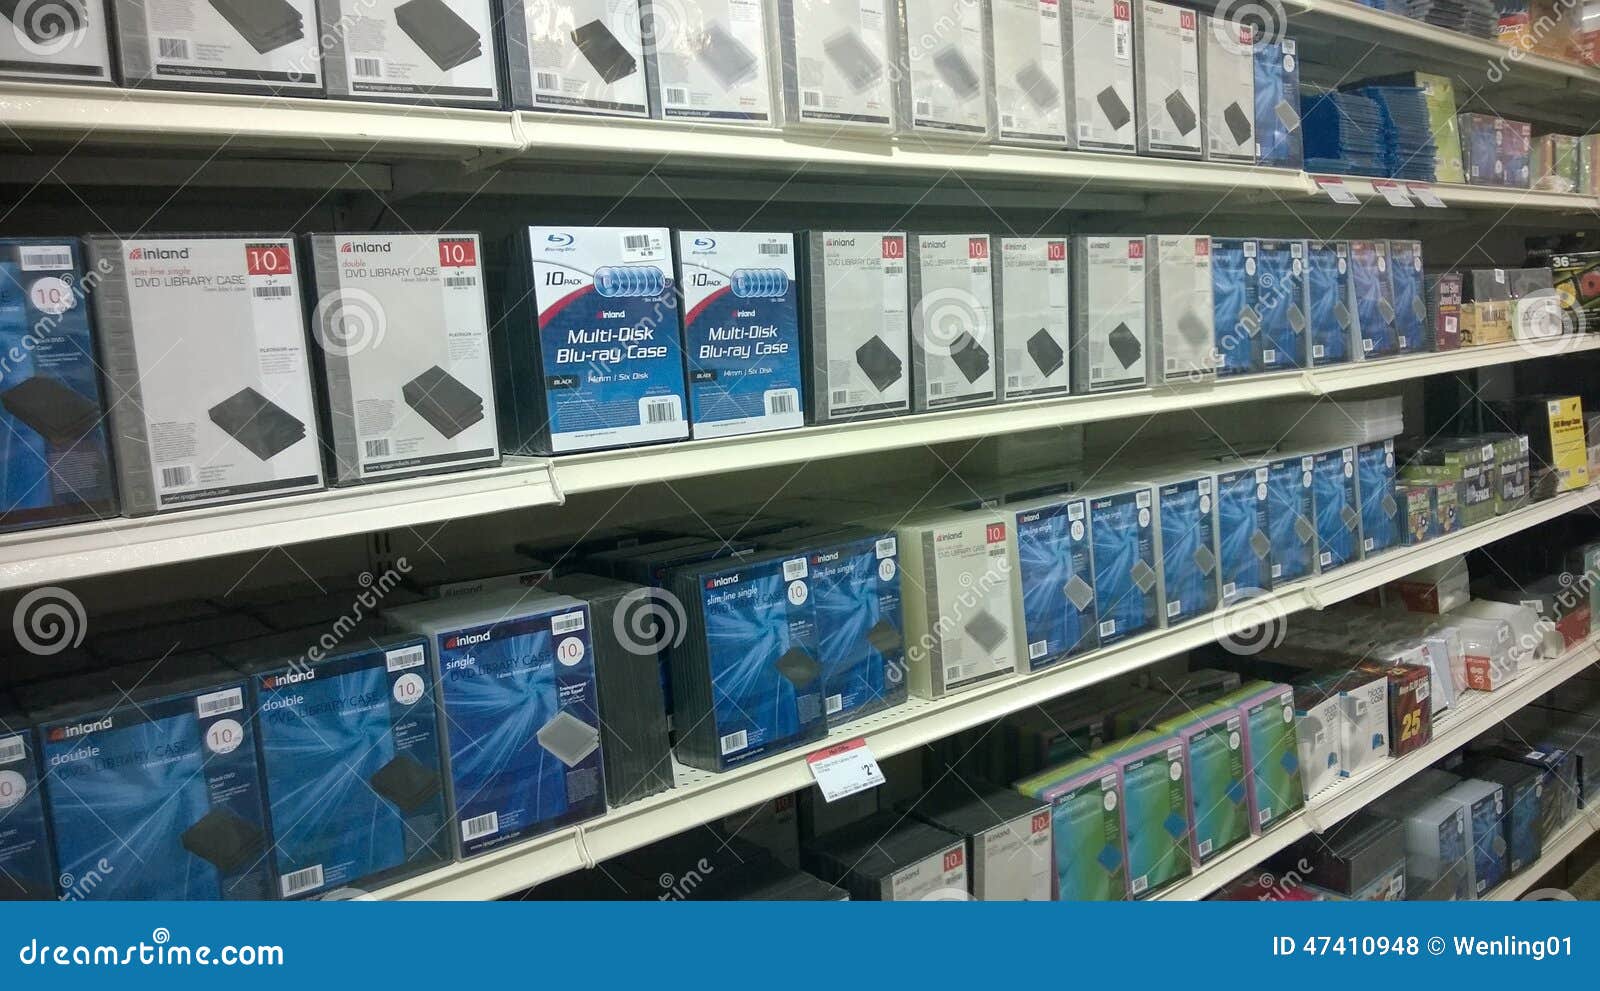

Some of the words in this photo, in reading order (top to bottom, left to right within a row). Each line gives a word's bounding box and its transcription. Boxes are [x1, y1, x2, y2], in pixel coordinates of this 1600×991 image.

[353, 242, 392, 253] inland
[832, 238, 855, 247] inland
[883, 241, 898, 256] 10
[928, 240, 946, 249] inland
[970, 242, 983, 257] 10
[143, 247, 189, 260] inland
[443, 244, 465, 263] 10
[1049, 245, 1060, 258] 10
[251, 250, 277, 271] 10
[343, 259, 366, 268] double
[842, 258, 866, 266] LIBRARY
[1552, 256, 1570, 268] 36
[345, 268, 367, 278] DVD
[369, 267, 410, 278] LIBRARY
[413, 266, 438, 276] CASE
[545, 271, 564, 286] 10
[135, 277, 160, 288] DVD
[165, 275, 212, 287] LIBRARY
[216, 274, 246, 285] CASE
[692, 273, 707, 287] 10
[37, 288, 60, 304] 10
[602, 310, 625, 319] inland
[736, 309, 756, 318] inland
[567, 326, 654, 344] Multi-Disk
[708, 325, 778, 341] Multi-Disk
[556, 348, 621, 364] Blu-ray
[627, 345, 668, 359] Case
[699, 344, 751, 359] Blu-ray
[755, 342, 788, 355] Case
[632, 372, 649, 380] Disk
[817, 551, 839, 563] inland
[713, 574, 740, 588] inland
[790, 586, 803, 599] 10
[456, 631, 491, 647] inland
[561, 643, 578, 658] 10
[446, 654, 475, 670] single
[275, 669, 315, 686] inland
[398, 682, 416, 697] 10
[263, 694, 304, 712] double
[65, 716, 113, 738] inland
[1401, 708, 1422, 741] 25
[211, 728, 232, 746] 10
[51, 746, 100, 766] double
